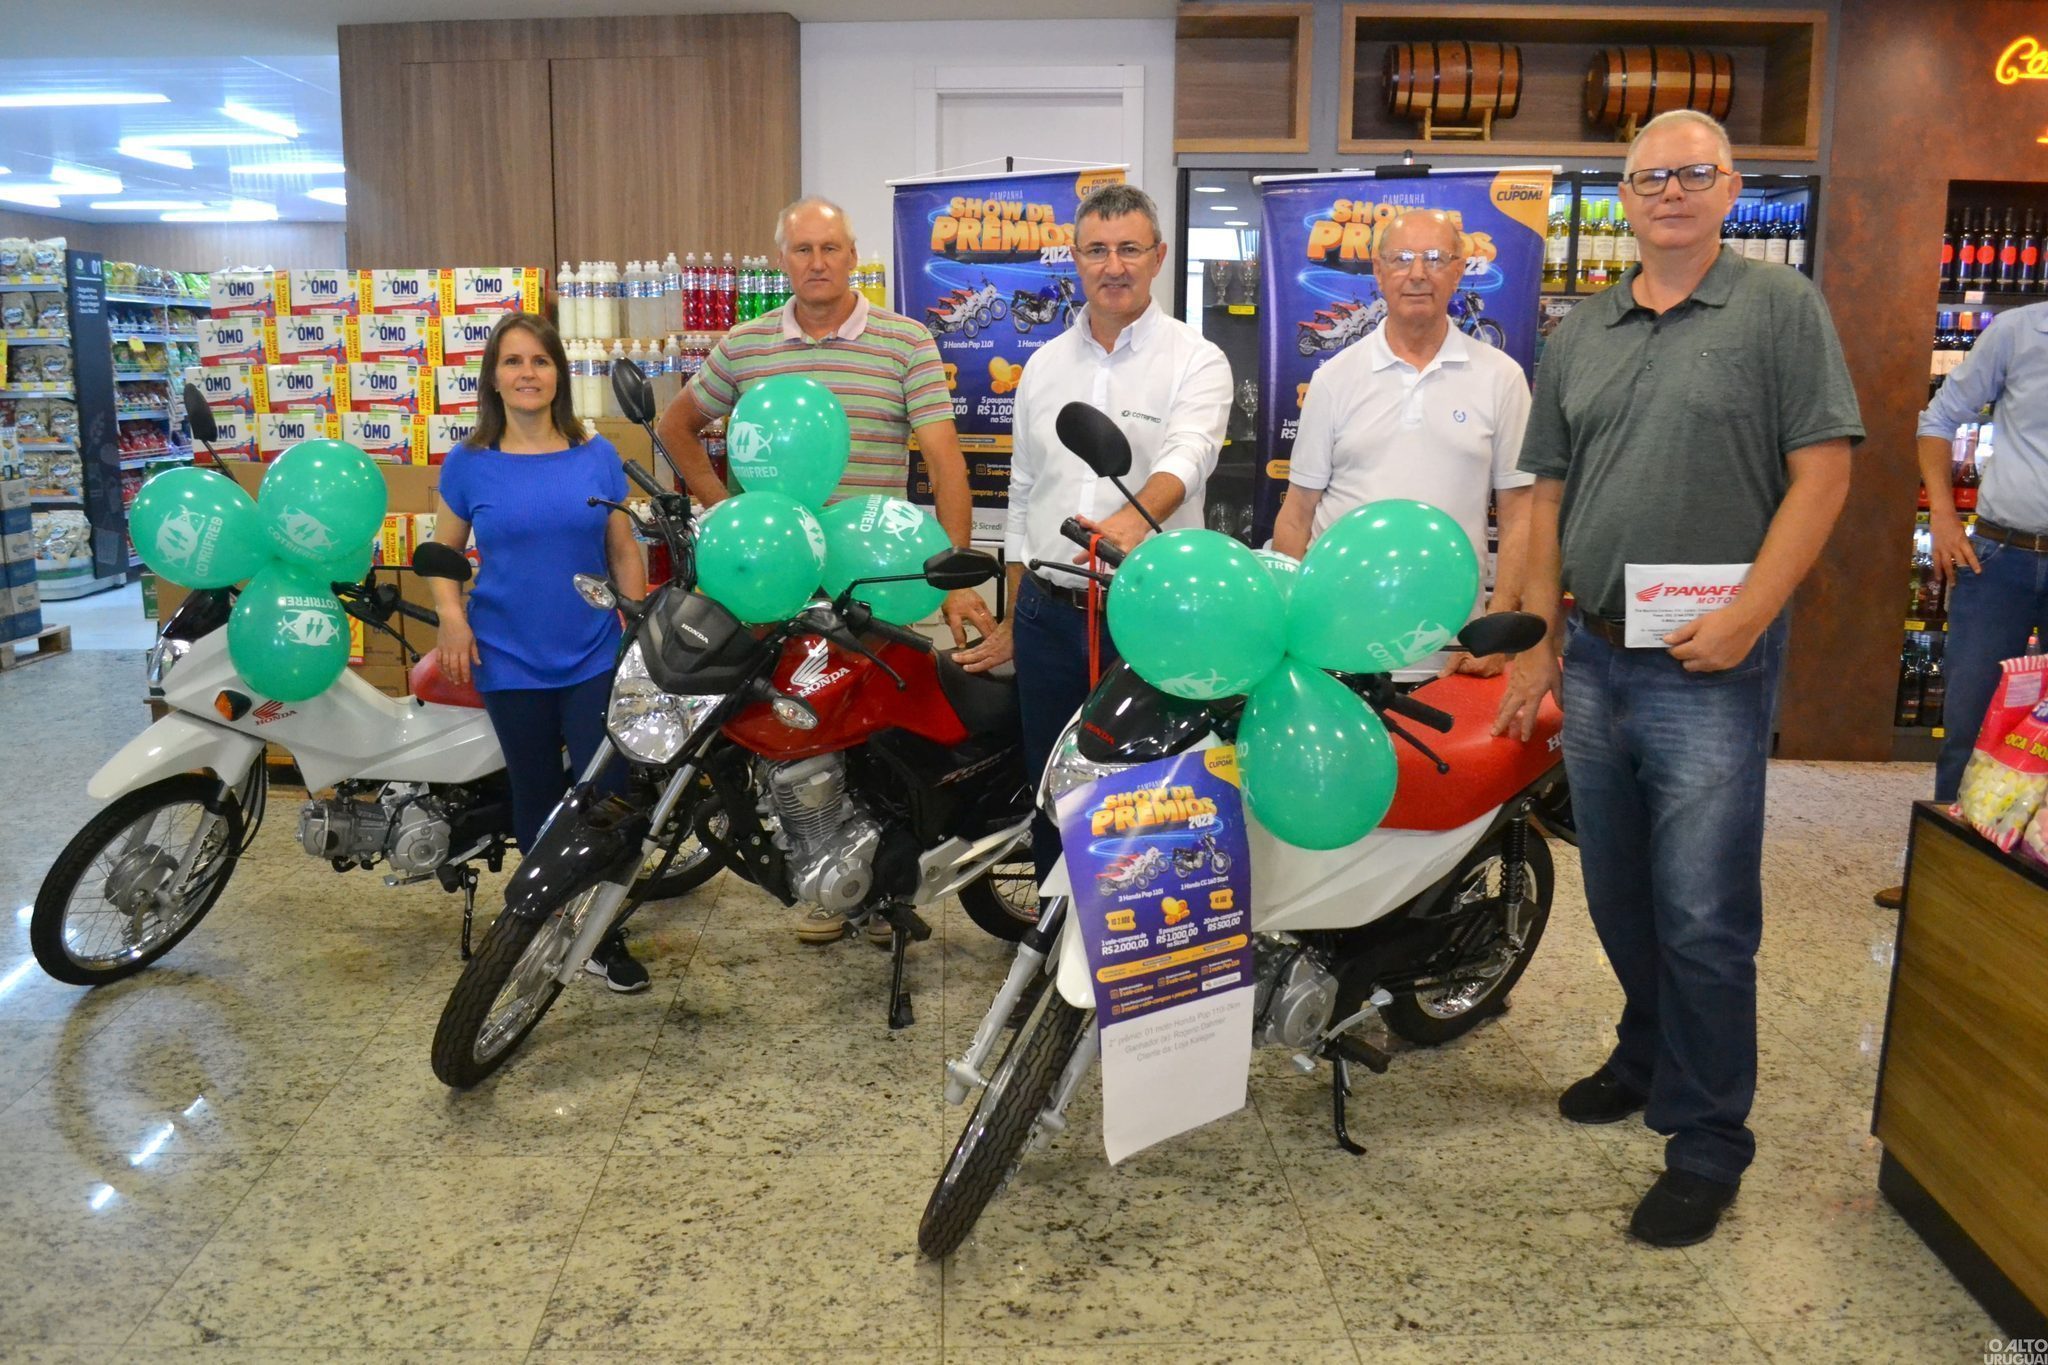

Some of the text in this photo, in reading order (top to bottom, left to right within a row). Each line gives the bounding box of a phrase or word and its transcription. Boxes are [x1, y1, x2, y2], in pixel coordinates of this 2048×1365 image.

[989, 190, 1023, 200] CAMPANHA
[1382, 193, 1425, 205] CAMPANHA
[1496, 191, 1543, 201] CUPOM!
[950, 197, 1055, 222] SHOW DE
[1464, 256, 1489, 276] 23
[229, 283, 254, 297] OMO
[311, 280, 338, 294] OMO
[392, 280, 418, 295] OMO
[475, 278, 502, 293] OMO
[217, 329, 243, 344] OMO
[297, 327, 324, 341] OMO
[380, 327, 406, 341] OMO
[968, 341, 980, 350] Pop
[205, 377, 231, 391] OMO
[287, 375, 313, 389] OMO
[370, 375, 397, 390] OMO
[459, 377, 478, 392] OM
[986, 398, 1014, 406] poupanç
[217, 425, 236, 439] MO
[279, 424, 305, 439] OMO
[363, 424, 390, 439] OMO
[978, 522, 1002, 531] Sicredi
[196, 516, 223, 577] COTRIFRED
[681, 623, 708, 644] HONDA
[799, 666, 850, 698] HONDA
[256, 710, 297, 726] HONDA
[1084, 721, 1115, 746] HONDA
[1104, 786, 1196, 809] SHOW DE
[1188, 814, 1215, 830] 2023
[1102, 939, 1149, 955] R$ 2.000,00
